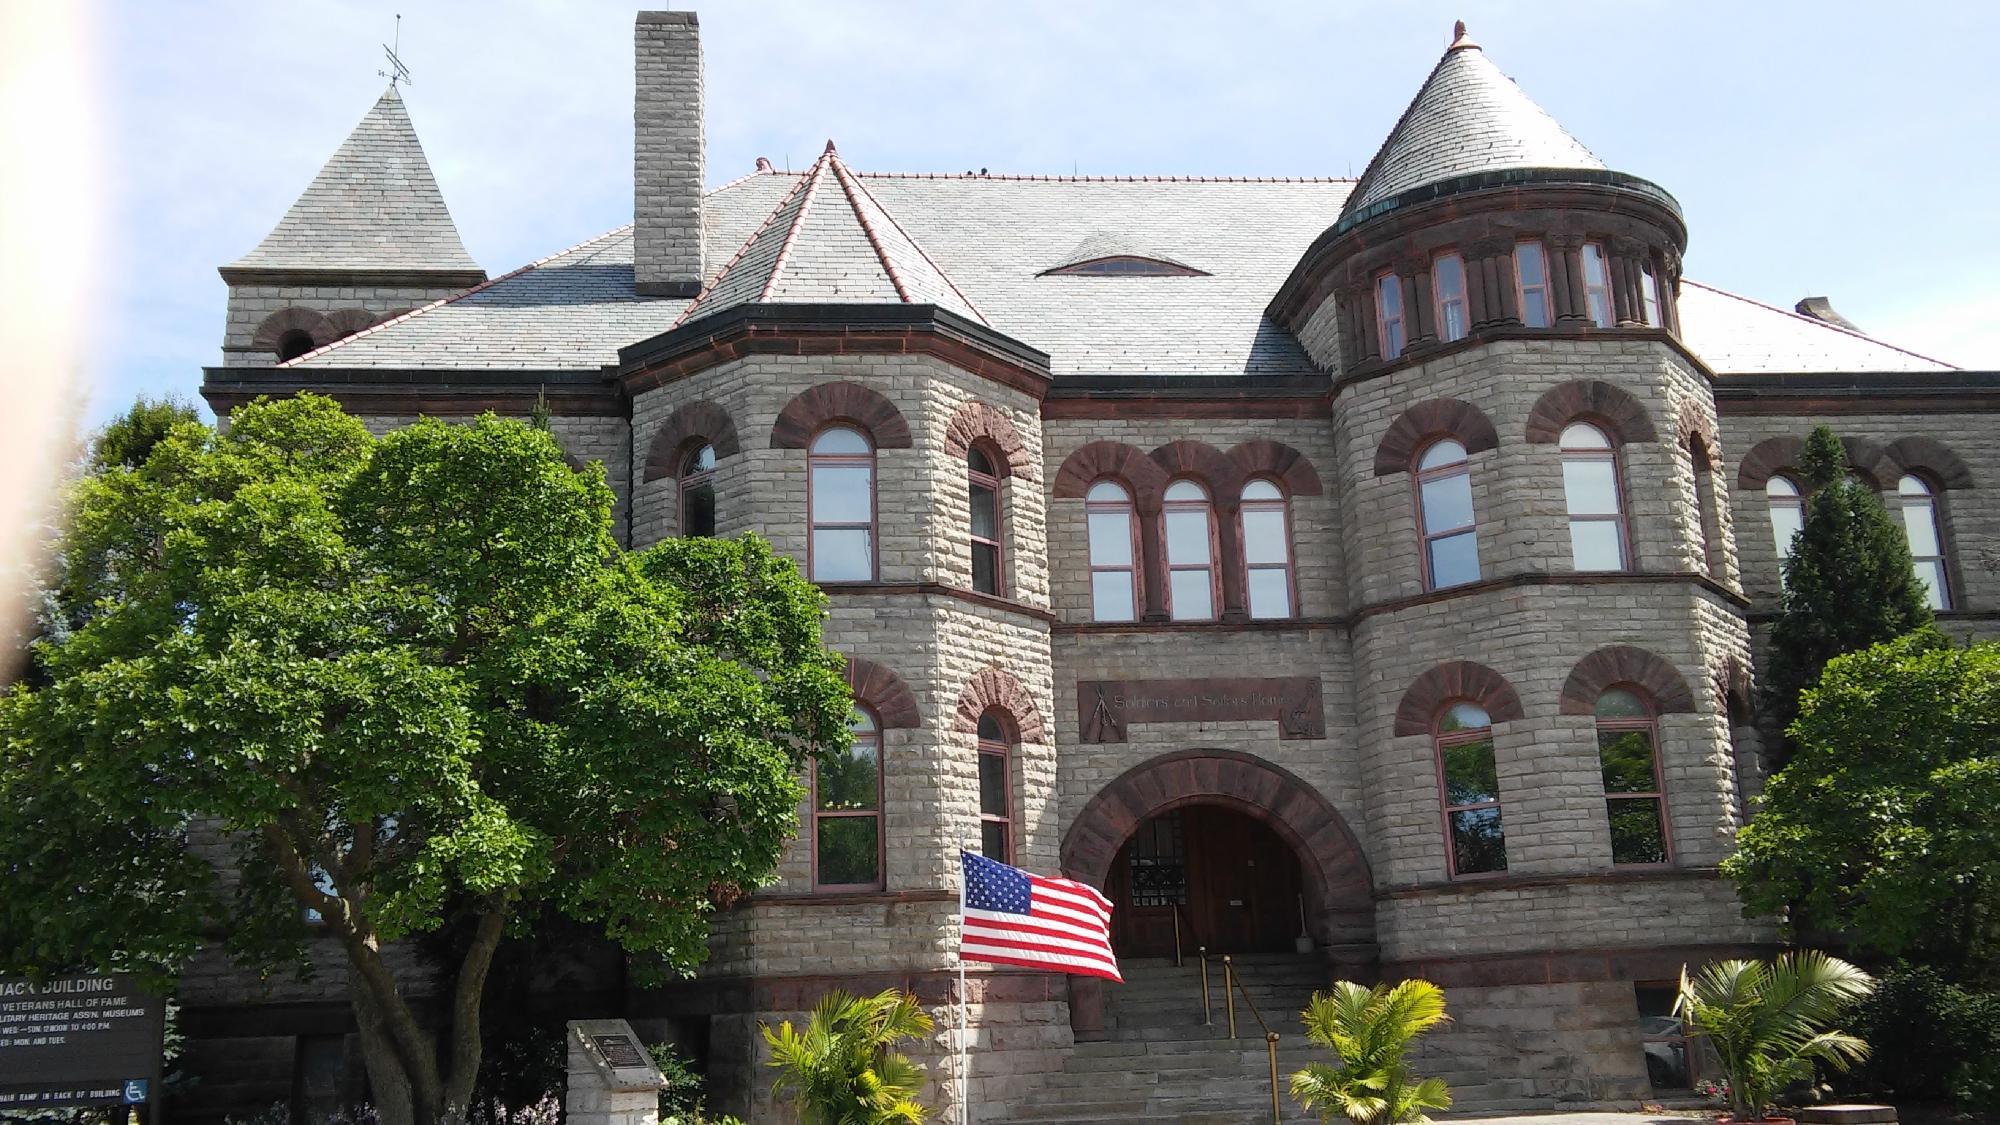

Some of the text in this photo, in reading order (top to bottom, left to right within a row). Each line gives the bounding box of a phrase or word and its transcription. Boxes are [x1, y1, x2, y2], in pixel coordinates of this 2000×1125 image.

[42, 979, 113, 994] BUILDING
[3, 997, 128, 1012] VETERANS HALL OF FAME
[28, 1012, 69, 1021] HERITAGE
[102, 1008, 145, 1018] MUSEUMS
[71, 1023, 80, 1031] TO
[81, 1022, 97, 1031] 4:00
[33, 1037, 47, 1045] AND
[19, 1093, 38, 1101] RAMP
[42, 1092, 51, 1100] IN
[53, 1091, 72, 1099] BACK
[76, 1090, 86, 1099] OF
[90, 1088, 121, 1098] BUILDING
